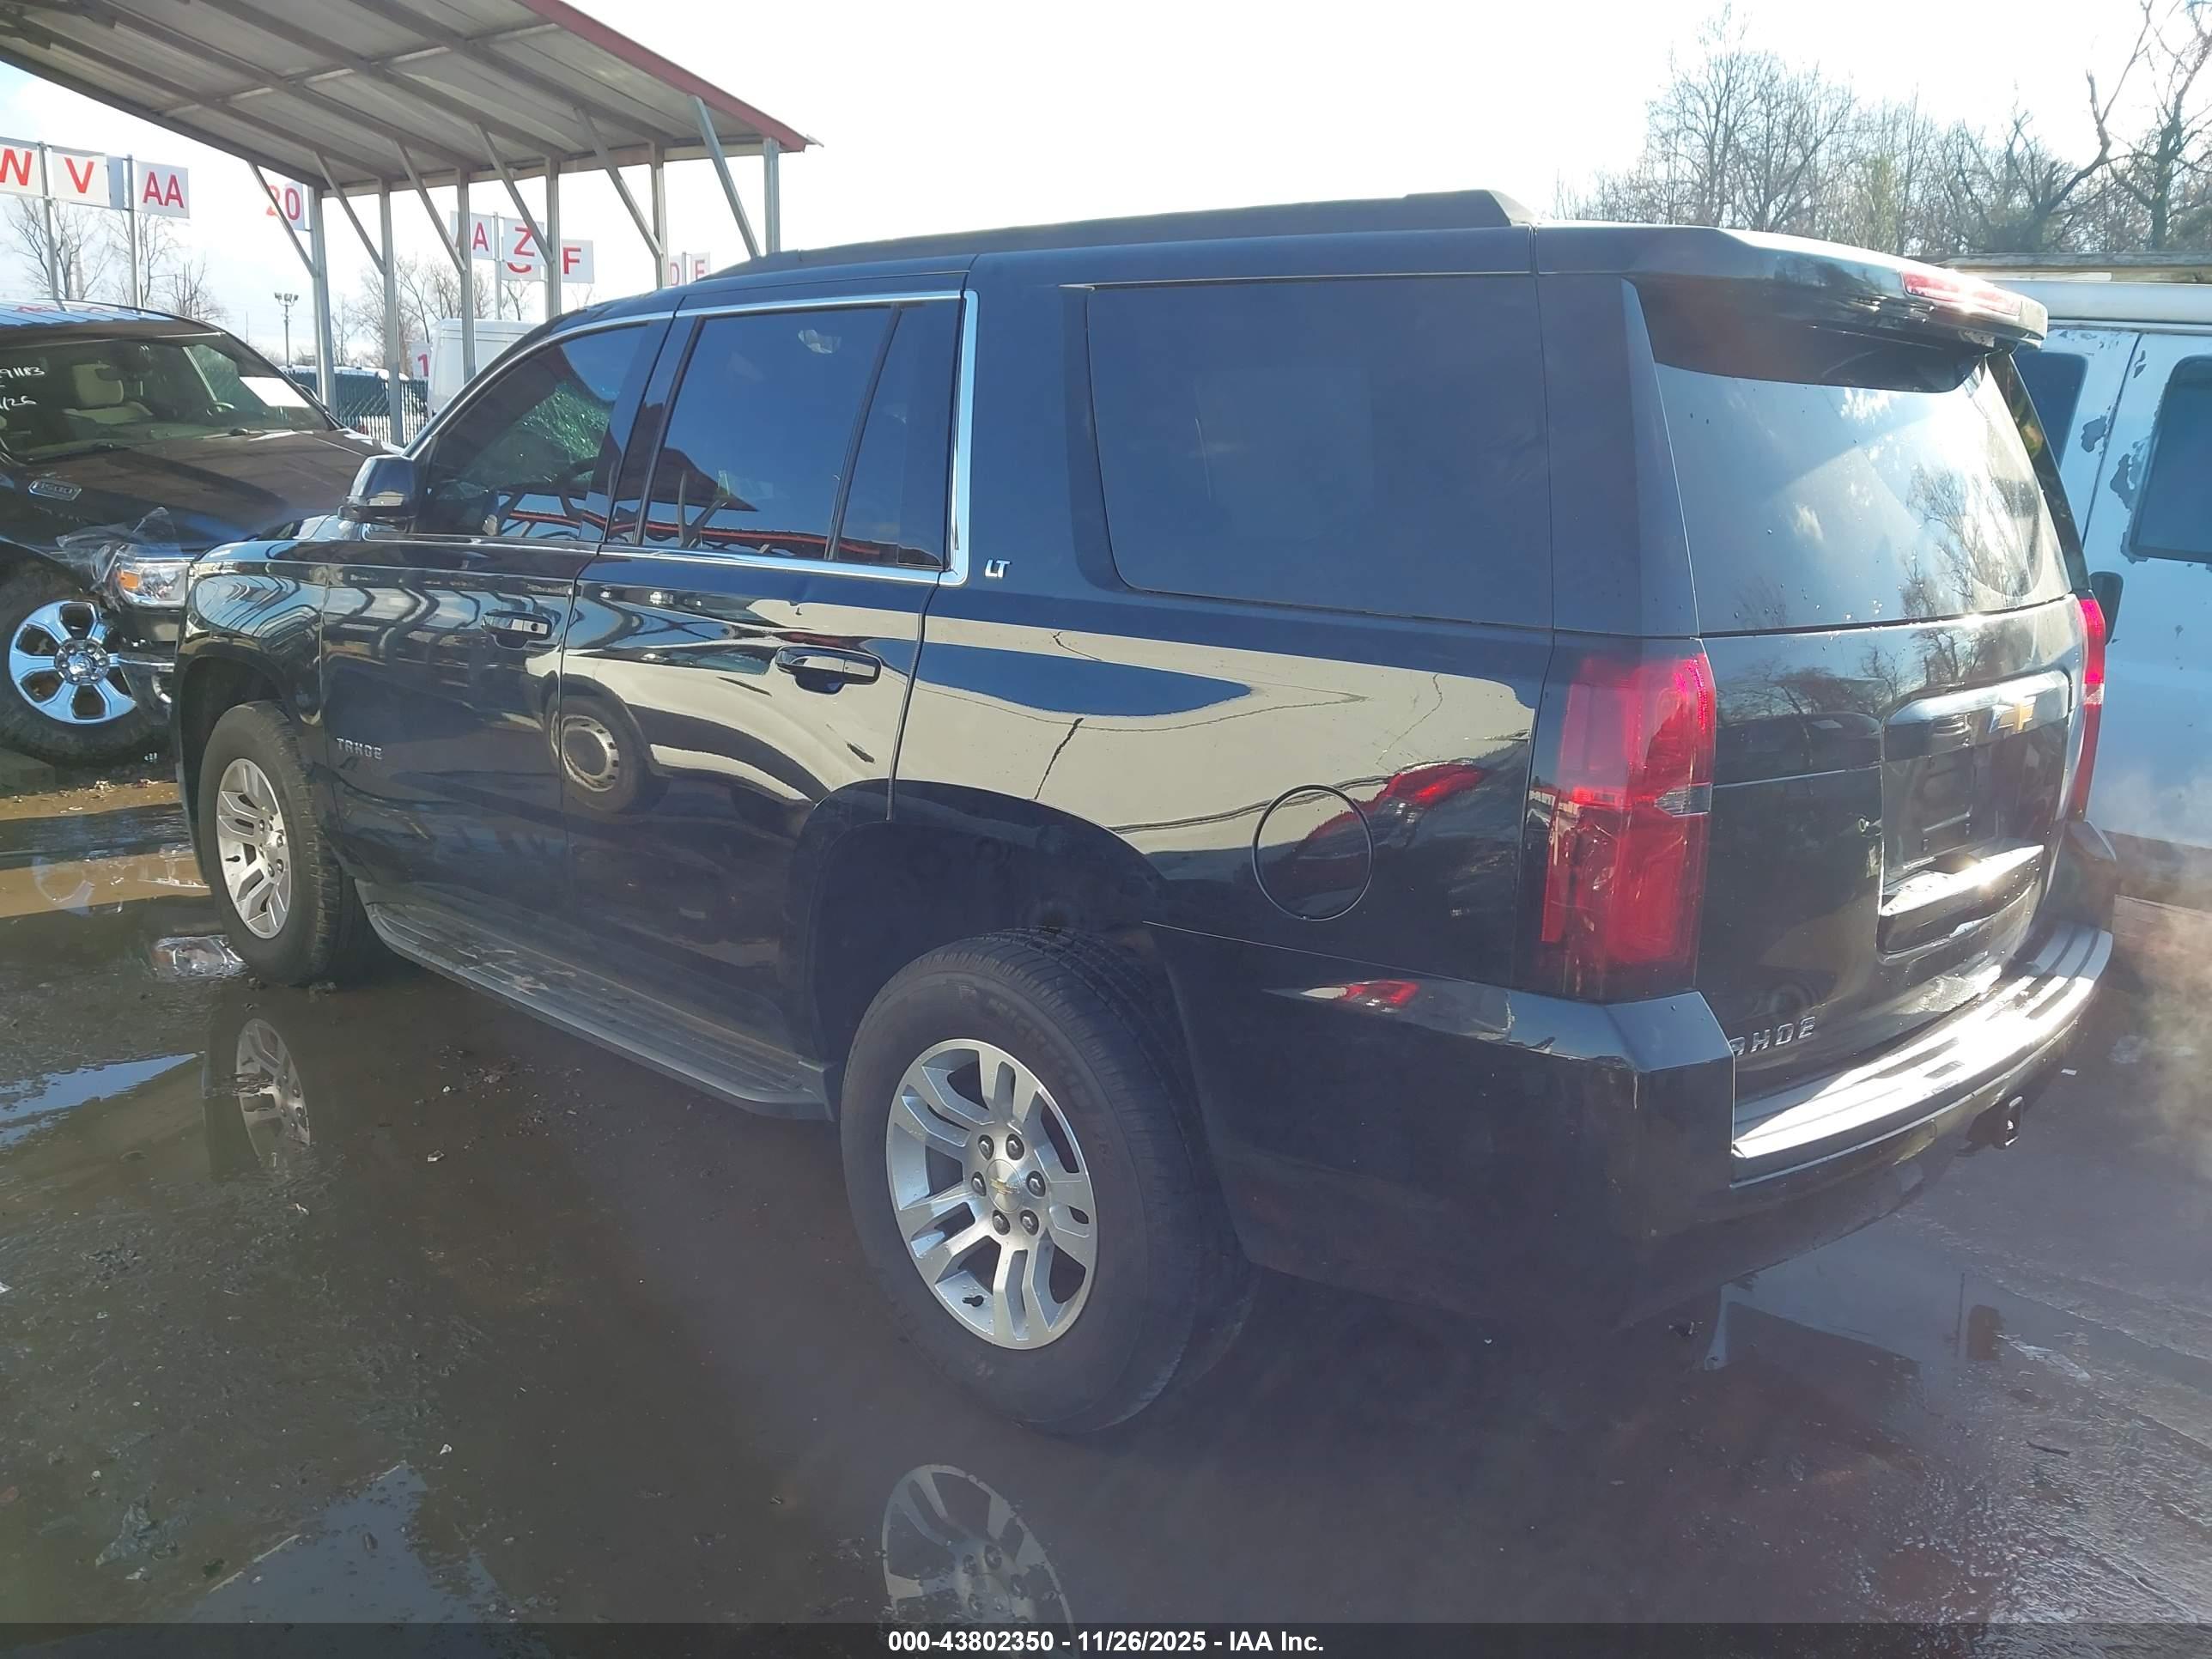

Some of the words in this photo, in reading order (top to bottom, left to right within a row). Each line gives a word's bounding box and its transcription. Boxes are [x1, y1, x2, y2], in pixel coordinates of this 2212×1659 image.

[64, 156, 94, 194] V
[142, 171, 185, 209] AA
[514, 226, 536, 257] Z
[562, 246, 581, 275] F
[985, 559, 1011, 578] LT
[336, 738, 383, 760] TAHOE
